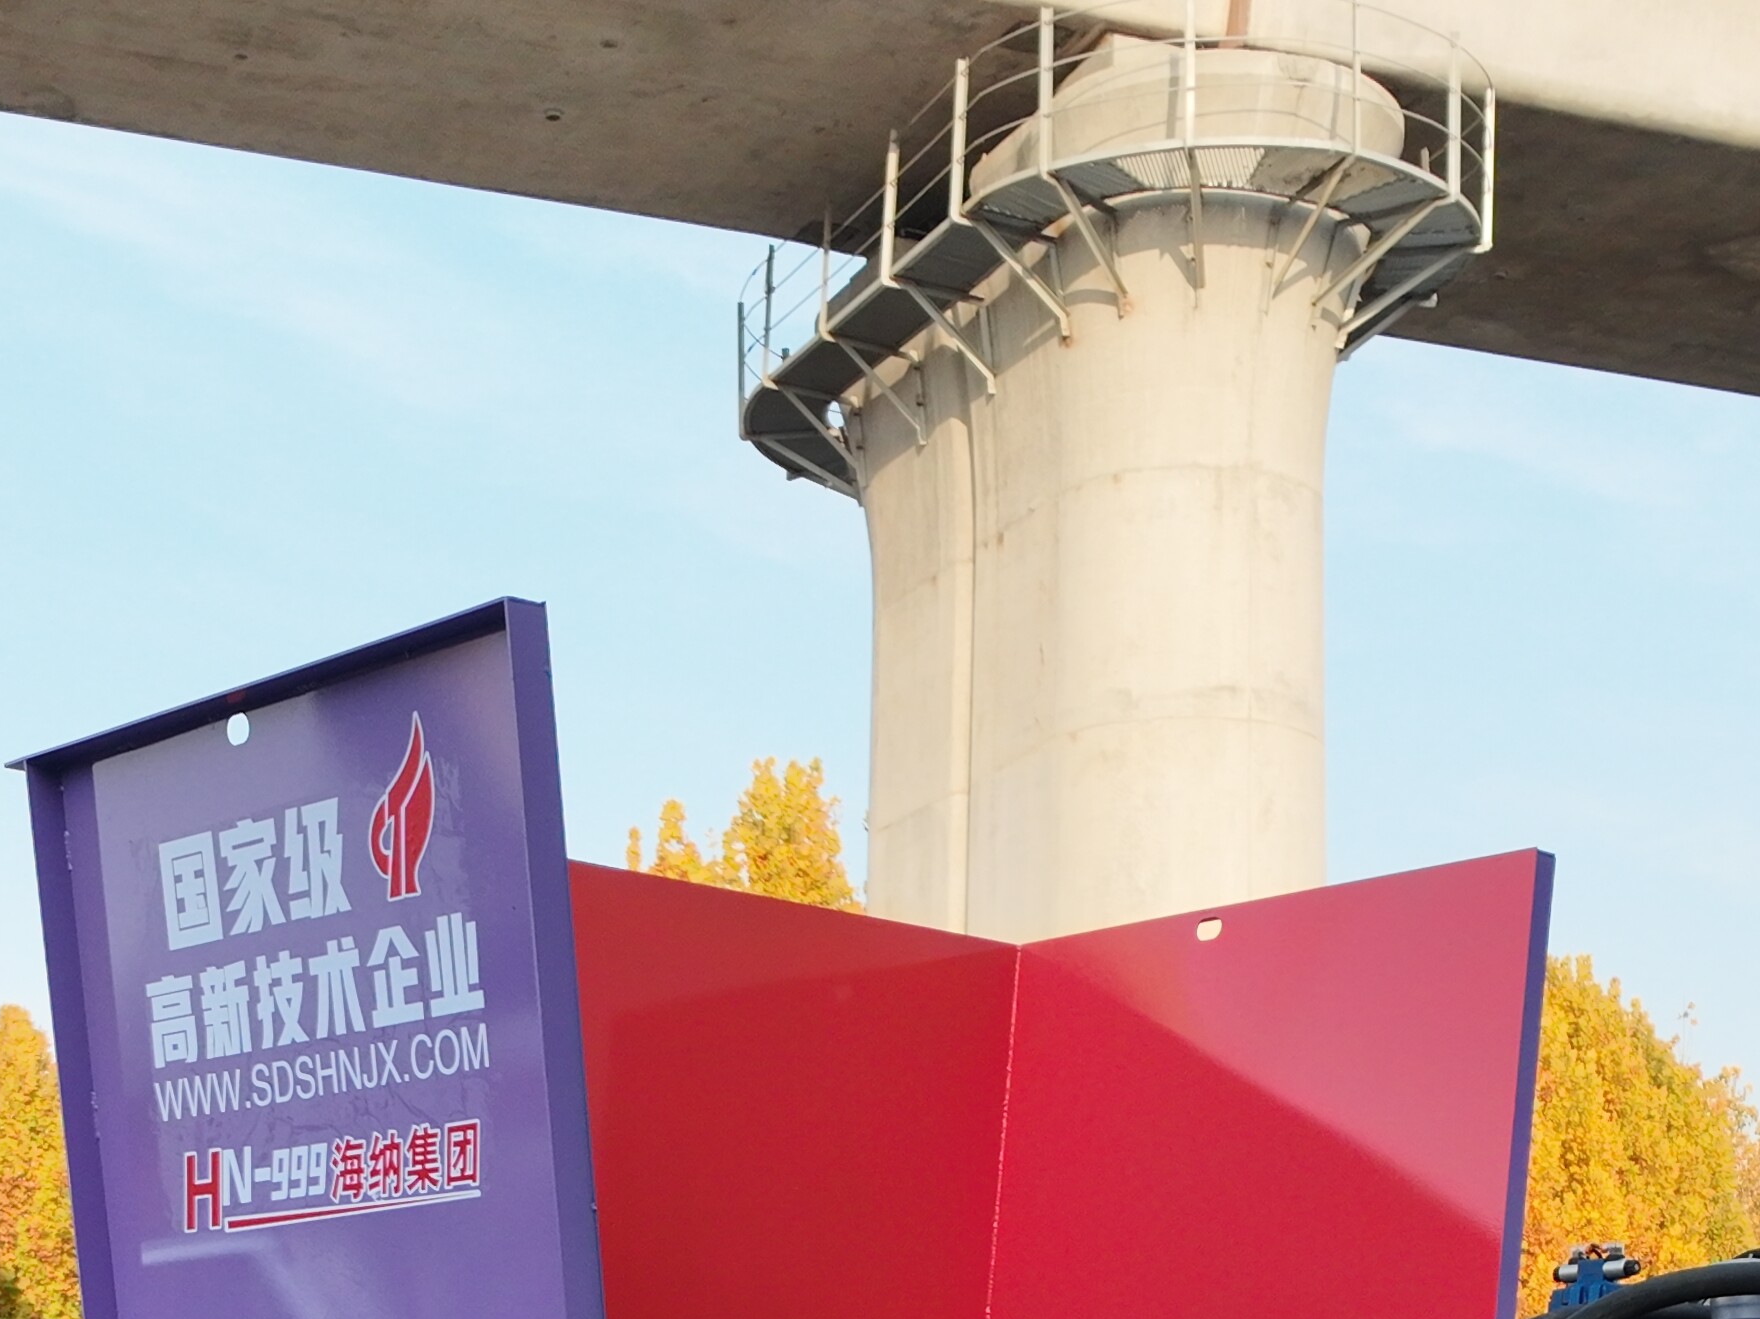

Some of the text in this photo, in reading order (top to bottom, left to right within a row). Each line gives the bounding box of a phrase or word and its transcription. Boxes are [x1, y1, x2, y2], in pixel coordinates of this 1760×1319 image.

[158, 796, 352, 951] 国家级
[146, 911, 485, 1069] 高新技术企业
[154, 1023, 490, 1122] WWW.SDSHNJX.COM
